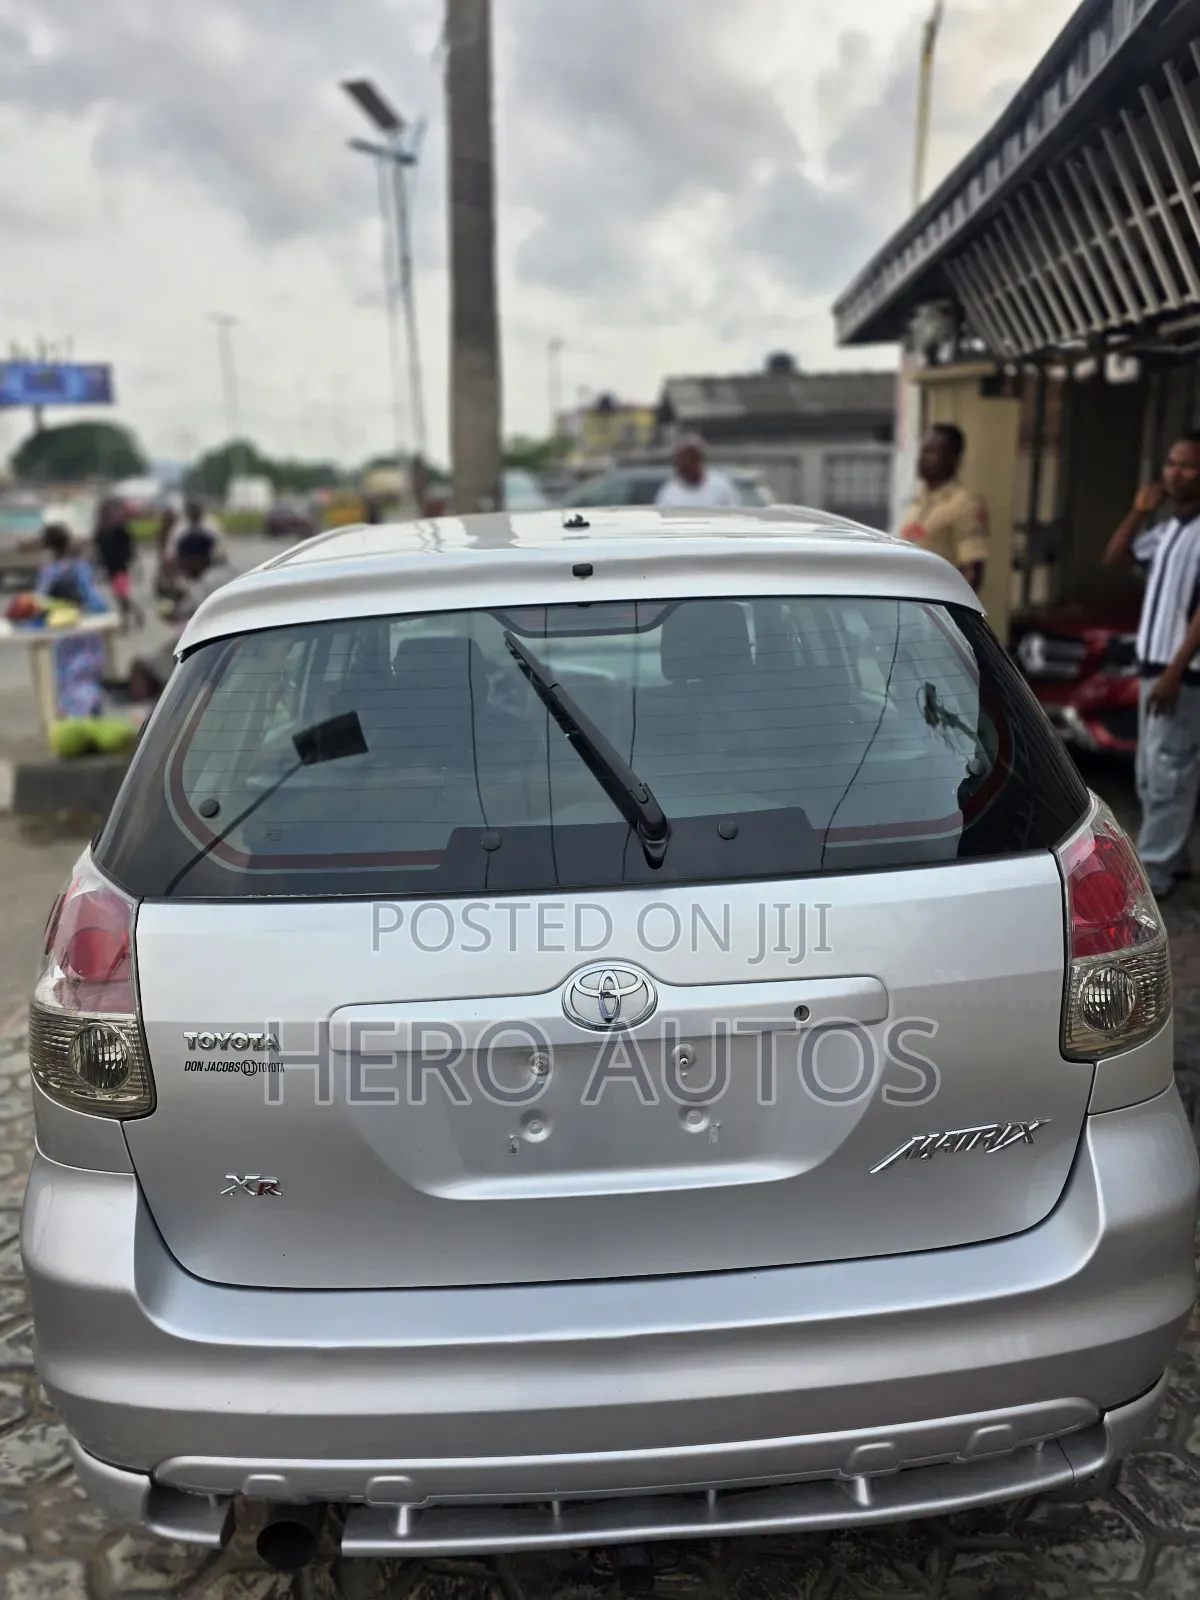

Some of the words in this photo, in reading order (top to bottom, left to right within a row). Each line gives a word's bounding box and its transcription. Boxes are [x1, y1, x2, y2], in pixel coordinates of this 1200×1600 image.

[183, 1031, 281, 1051] TOYOTA
[184, 1061, 202, 1072] DON
[204, 1061, 241, 1073] JACOBS
[258, 1062, 284, 1073] TOYOTA
[869, 1117, 1052, 1174] MATRIX
[220, 1173, 283, 1196] XR
